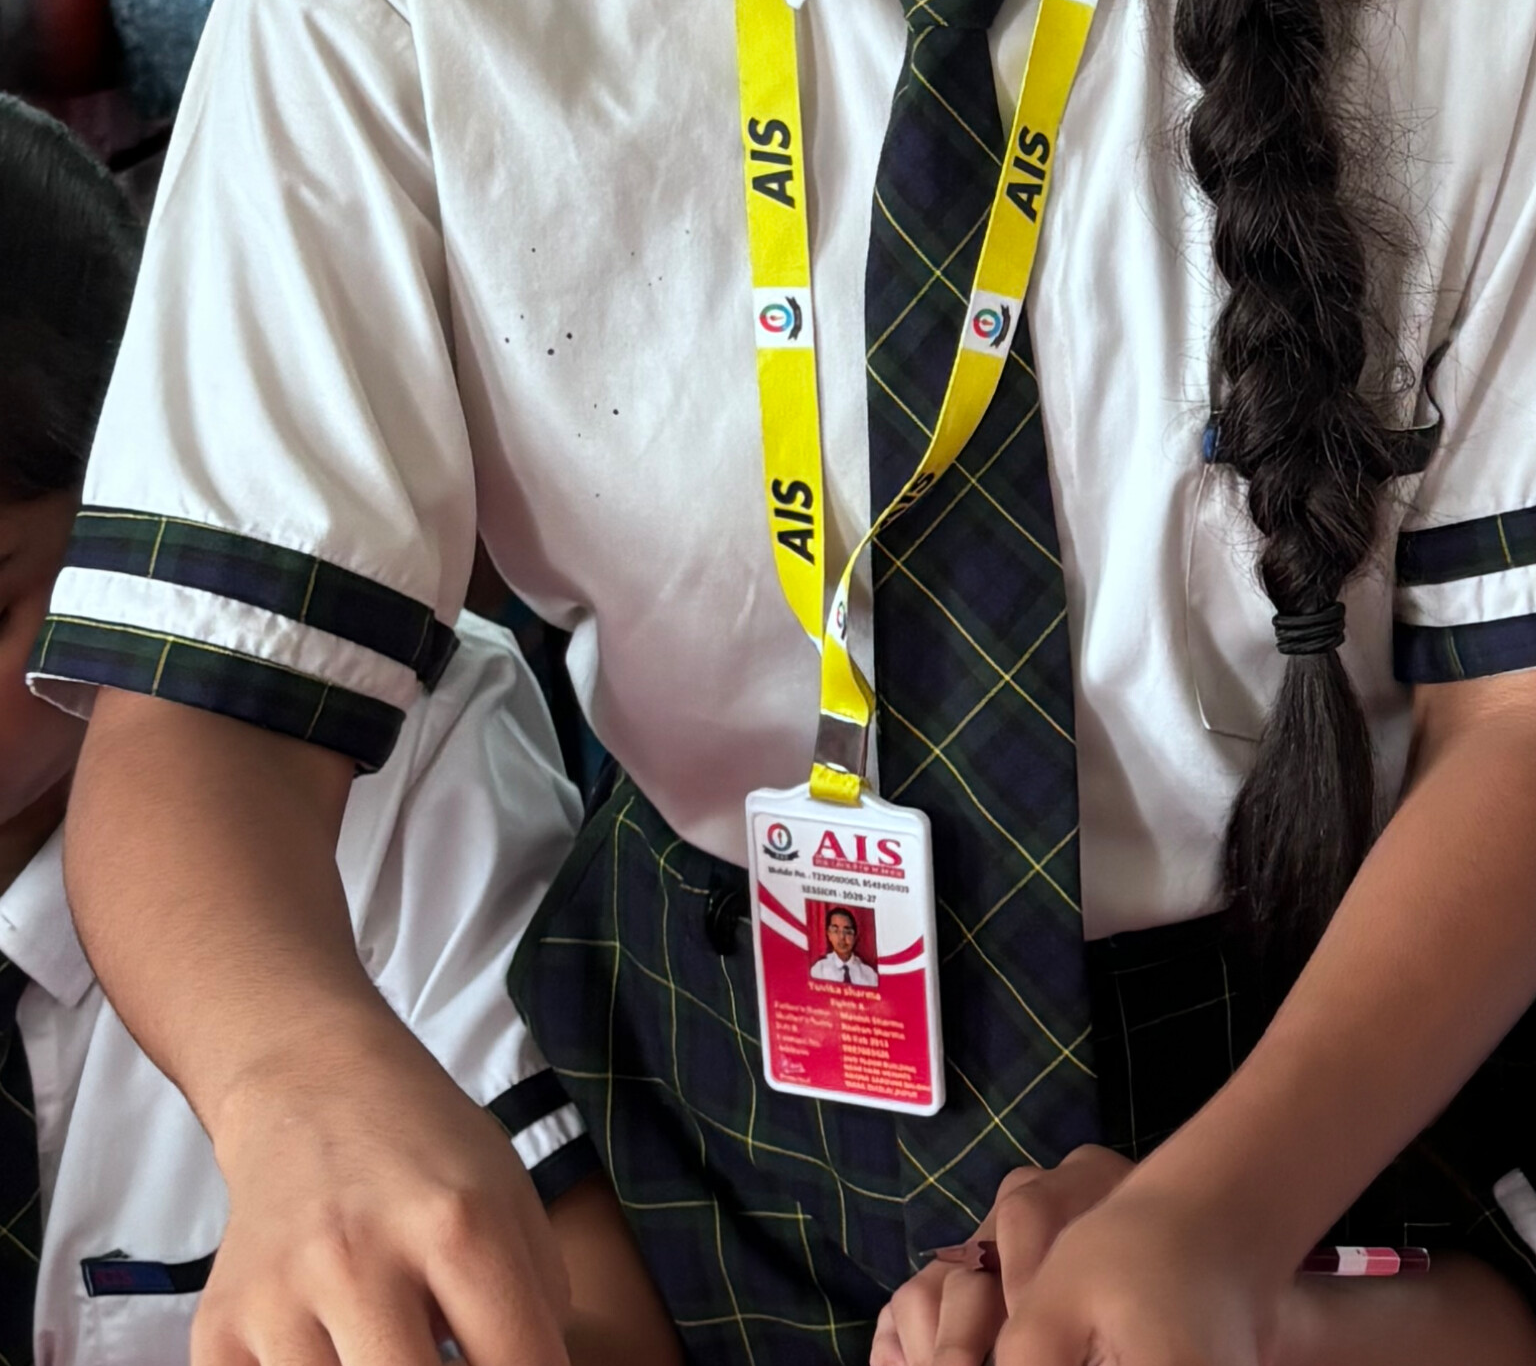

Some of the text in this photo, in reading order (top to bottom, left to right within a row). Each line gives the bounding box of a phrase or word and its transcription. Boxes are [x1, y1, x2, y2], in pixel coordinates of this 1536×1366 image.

[748, 116, 796, 209] AIS
[1004, 125, 1051, 223] AIS
[772, 477, 815, 565] AIS
[813, 829, 903, 867] AIS
